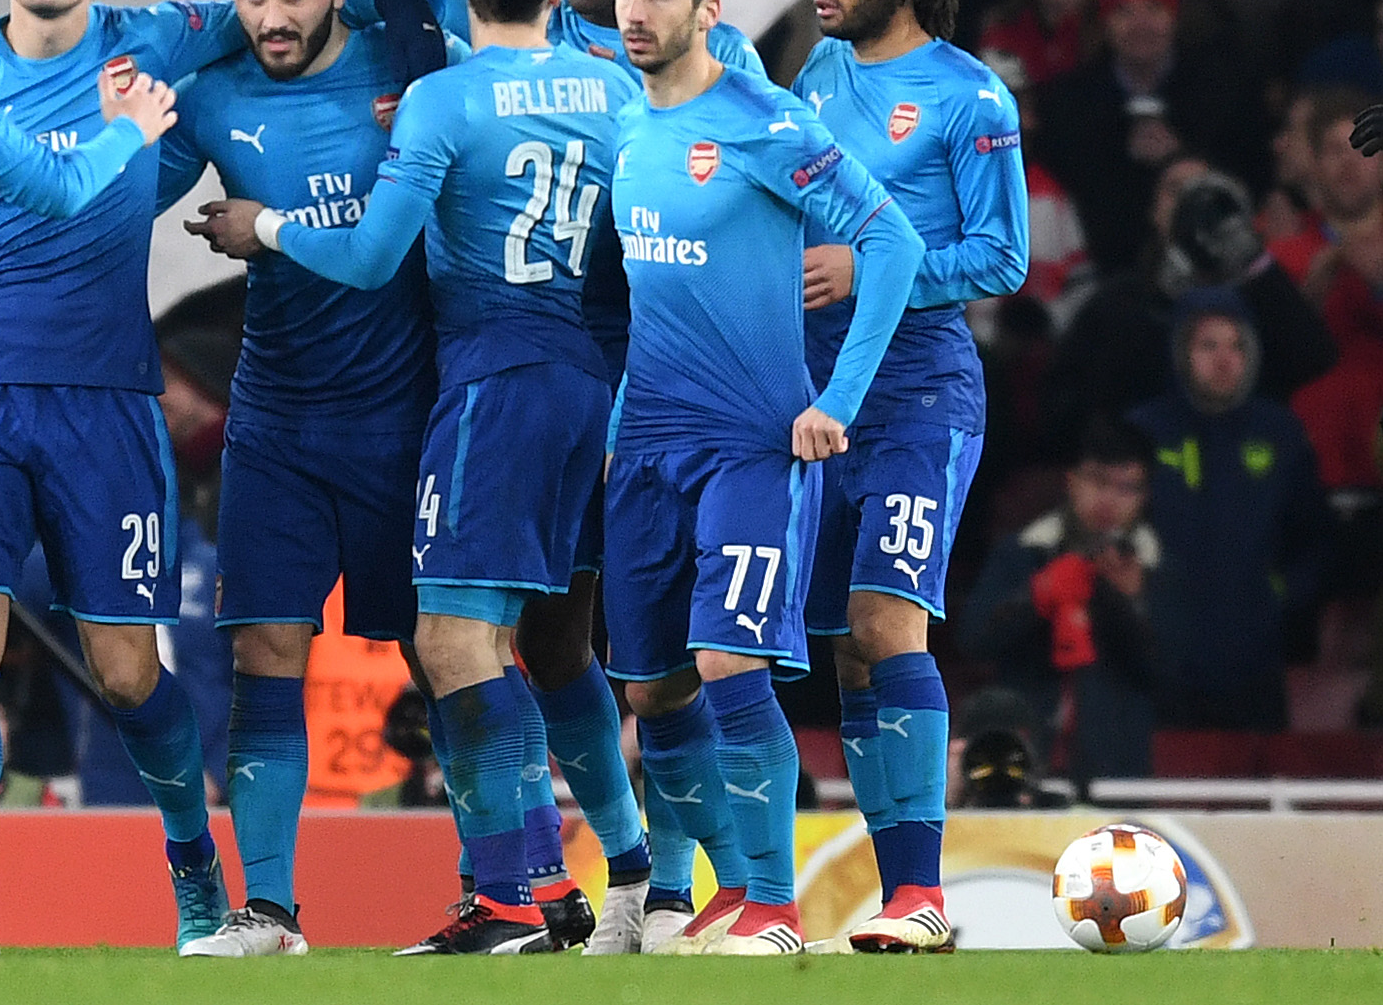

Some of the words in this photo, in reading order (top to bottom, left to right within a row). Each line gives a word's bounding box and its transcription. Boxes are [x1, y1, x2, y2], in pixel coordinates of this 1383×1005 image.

[493, 77, 607, 117] BELLERIN
[307, 173, 352, 197] Fly
[504, 140, 601, 284] 24
[631, 206, 660, 234] Fly
[121, 512, 160, 580] 29
[879, 494, 938, 560] 35
[722, 545, 782, 613] 77
